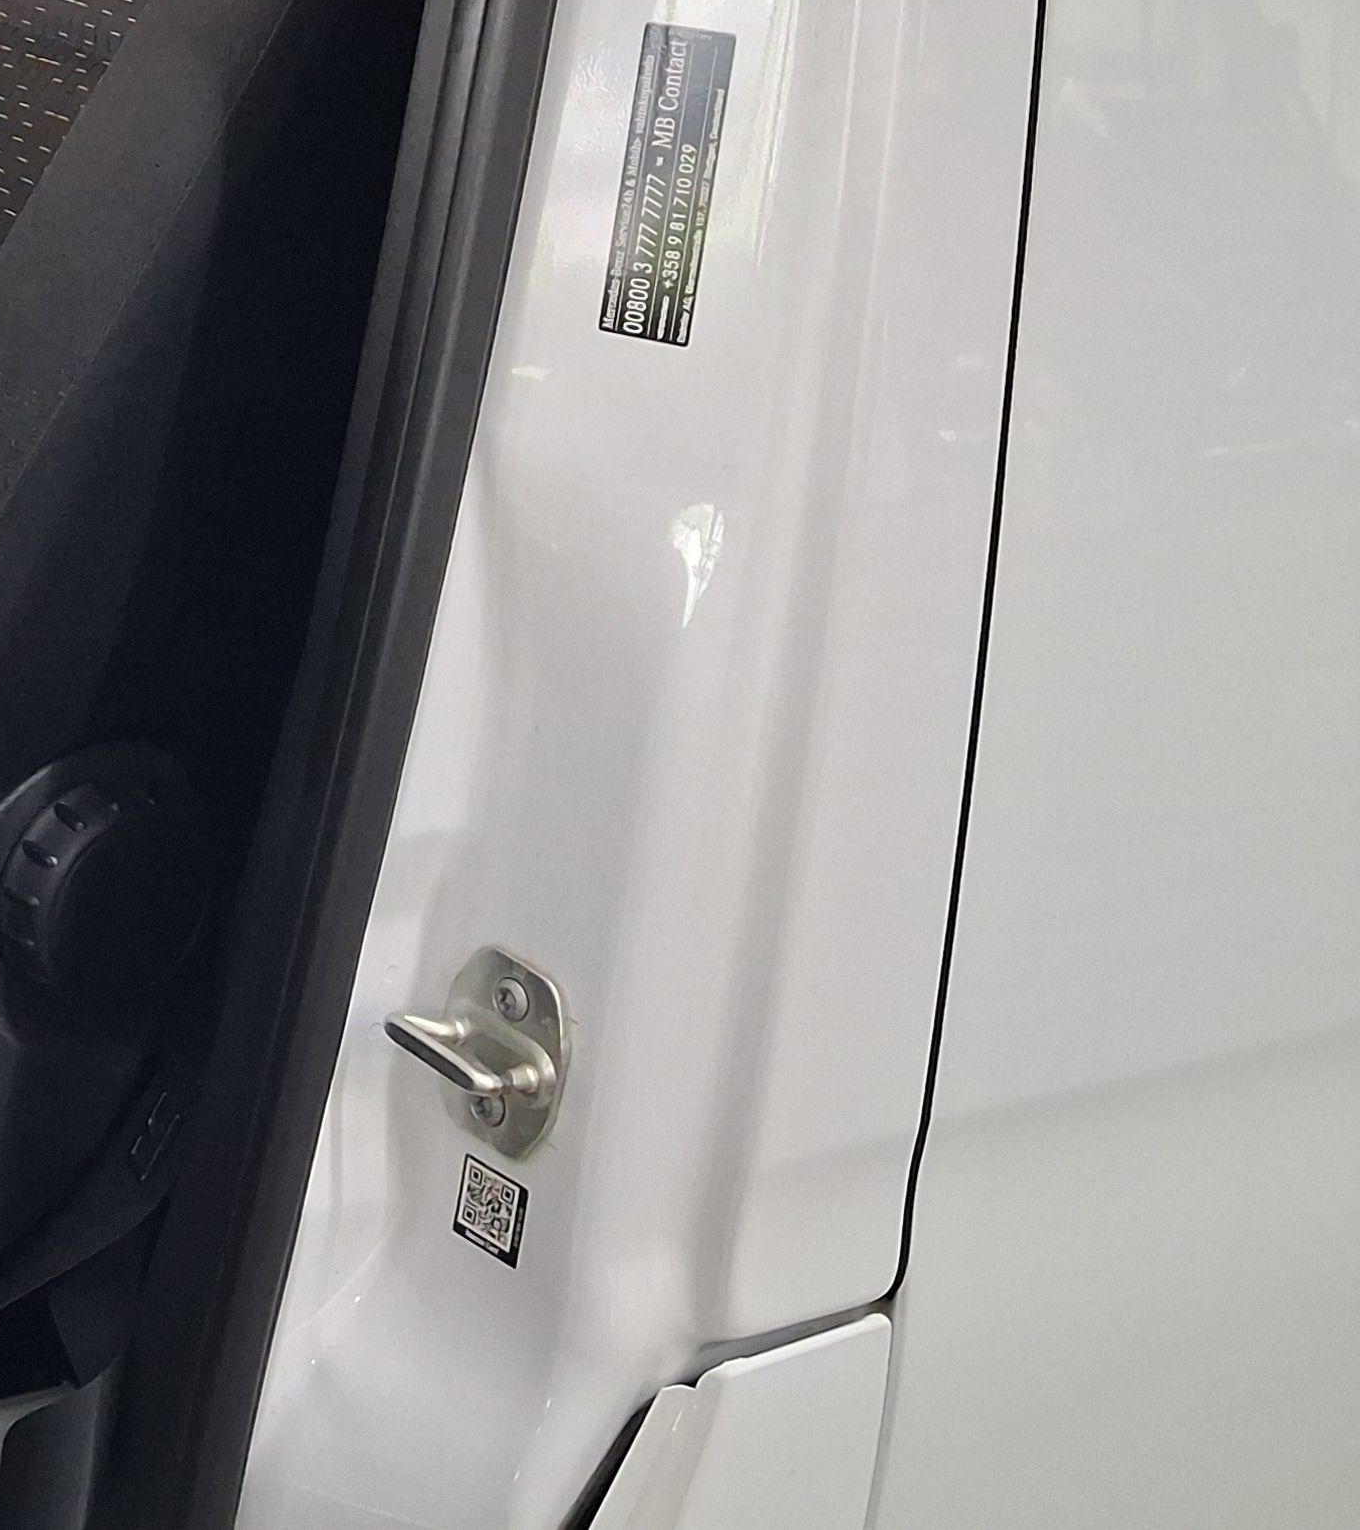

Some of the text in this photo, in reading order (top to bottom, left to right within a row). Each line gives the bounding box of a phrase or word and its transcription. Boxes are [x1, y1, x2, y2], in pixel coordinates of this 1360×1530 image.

[658, 39, 687, 112] Contact
[652, 116, 675, 149] MB
[679, 143, 697, 173] 029
[642, 174, 666, 219] 7777
[674, 177, 692, 207] 710
[670, 212, 686, 231] 81
[636, 223, 658, 257] 777
[667, 236, 682, 245] 9
[633, 261, 653, 274] 3
[661, 249, 680, 289] +358
[623, 277, 650, 334] 00800
